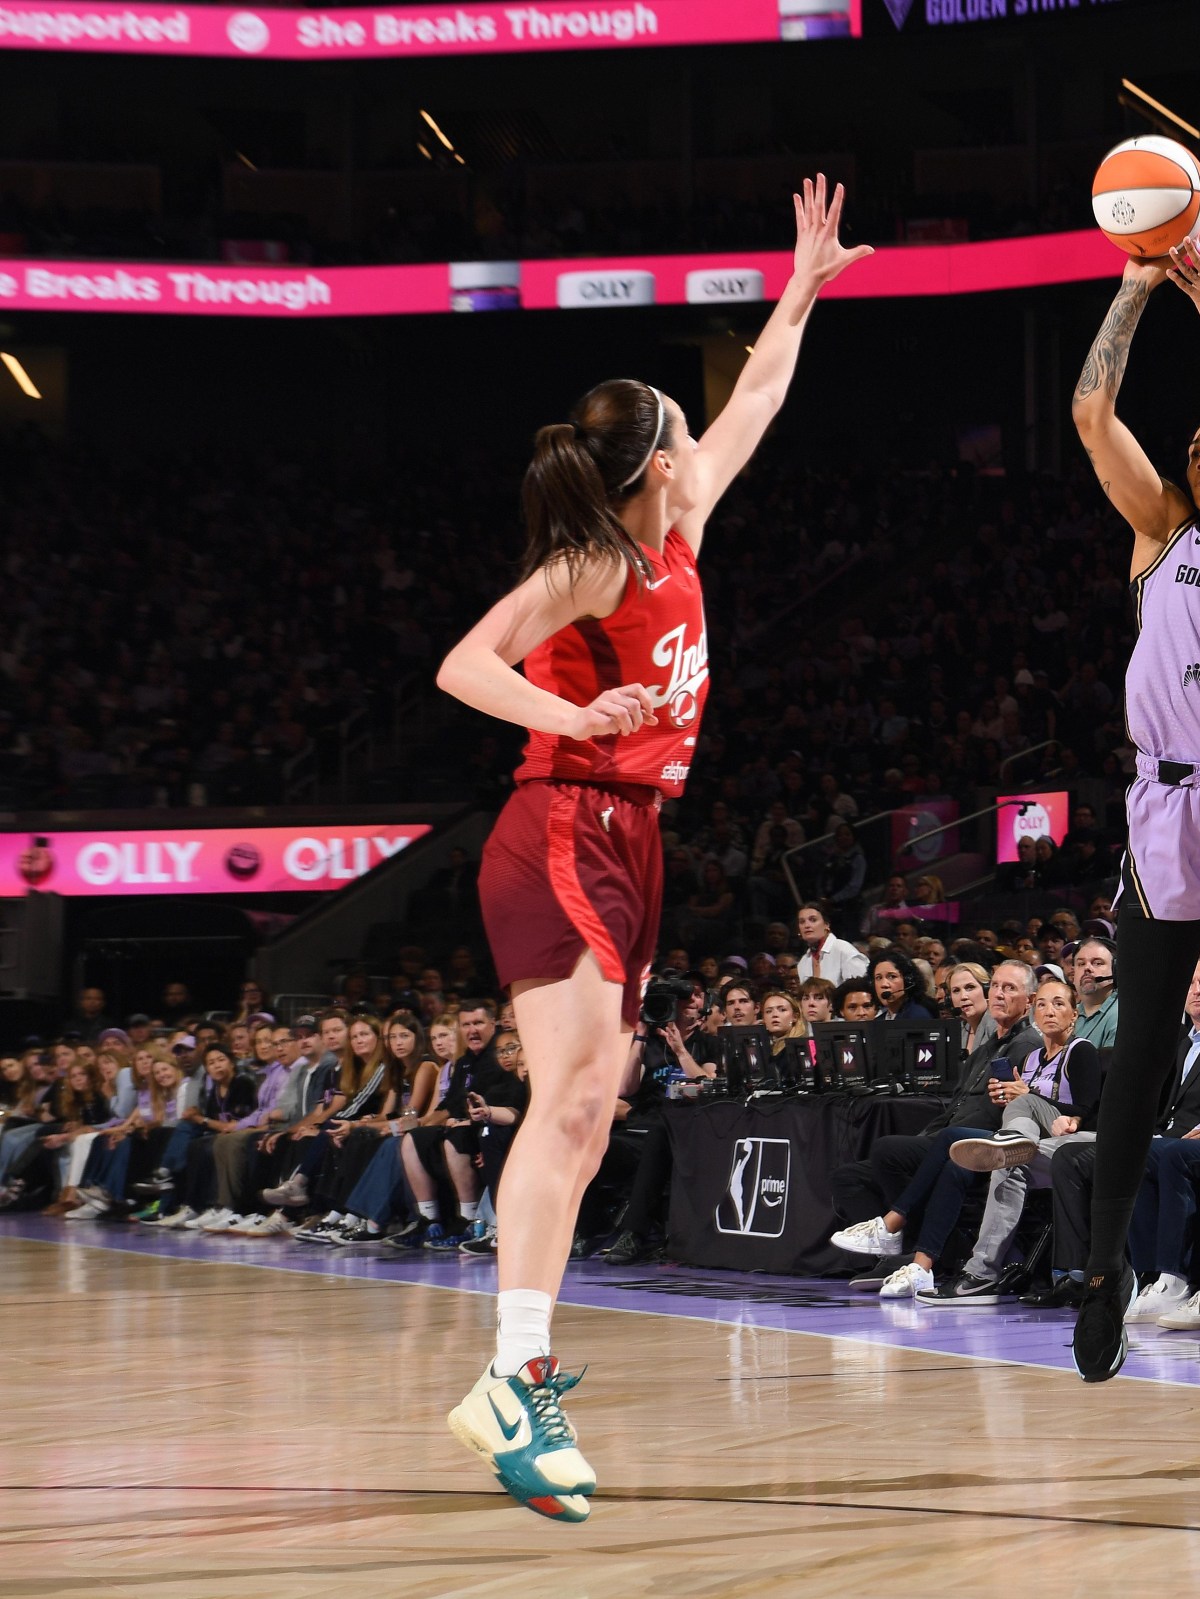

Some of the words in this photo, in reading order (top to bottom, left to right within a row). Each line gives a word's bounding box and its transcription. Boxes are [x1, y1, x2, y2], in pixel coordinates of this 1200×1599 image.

[297, 15, 365, 47] She
[374, 11, 497, 45] Breaks
[504, 3, 657, 40] Through
[25, 268, 160, 301] Breaks
[168, 272, 331, 310] Through
[578, 280, 635, 300] OLLY
[703, 278, 749, 296] OLLY
[1020, 816, 1043, 830] OLLY
[76, 840, 203, 885] OLLY
[760, 1176, 785, 1195] prime
